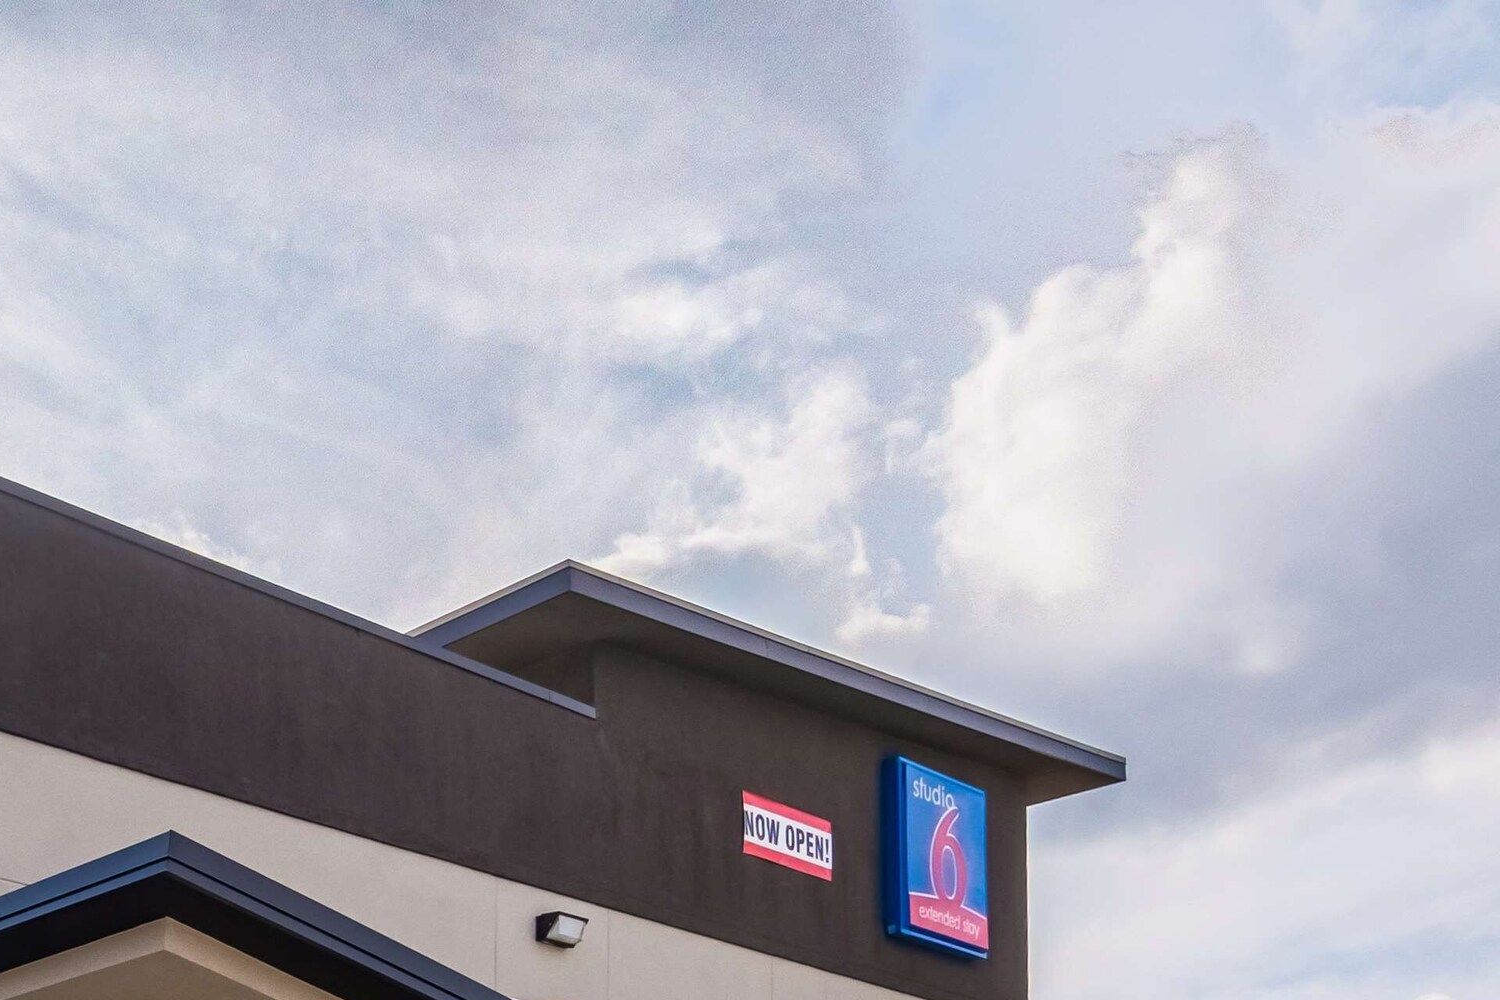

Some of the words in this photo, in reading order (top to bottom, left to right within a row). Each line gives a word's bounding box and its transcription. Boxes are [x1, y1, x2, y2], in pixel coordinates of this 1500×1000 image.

[913, 777, 954, 809] studio
[744, 811, 780, 846] NOW
[785, 825, 830, 863] OPEN!
[930, 807, 966, 905] 6
[918, 905, 961, 930] extended
[962, 919, 981, 940] stay
